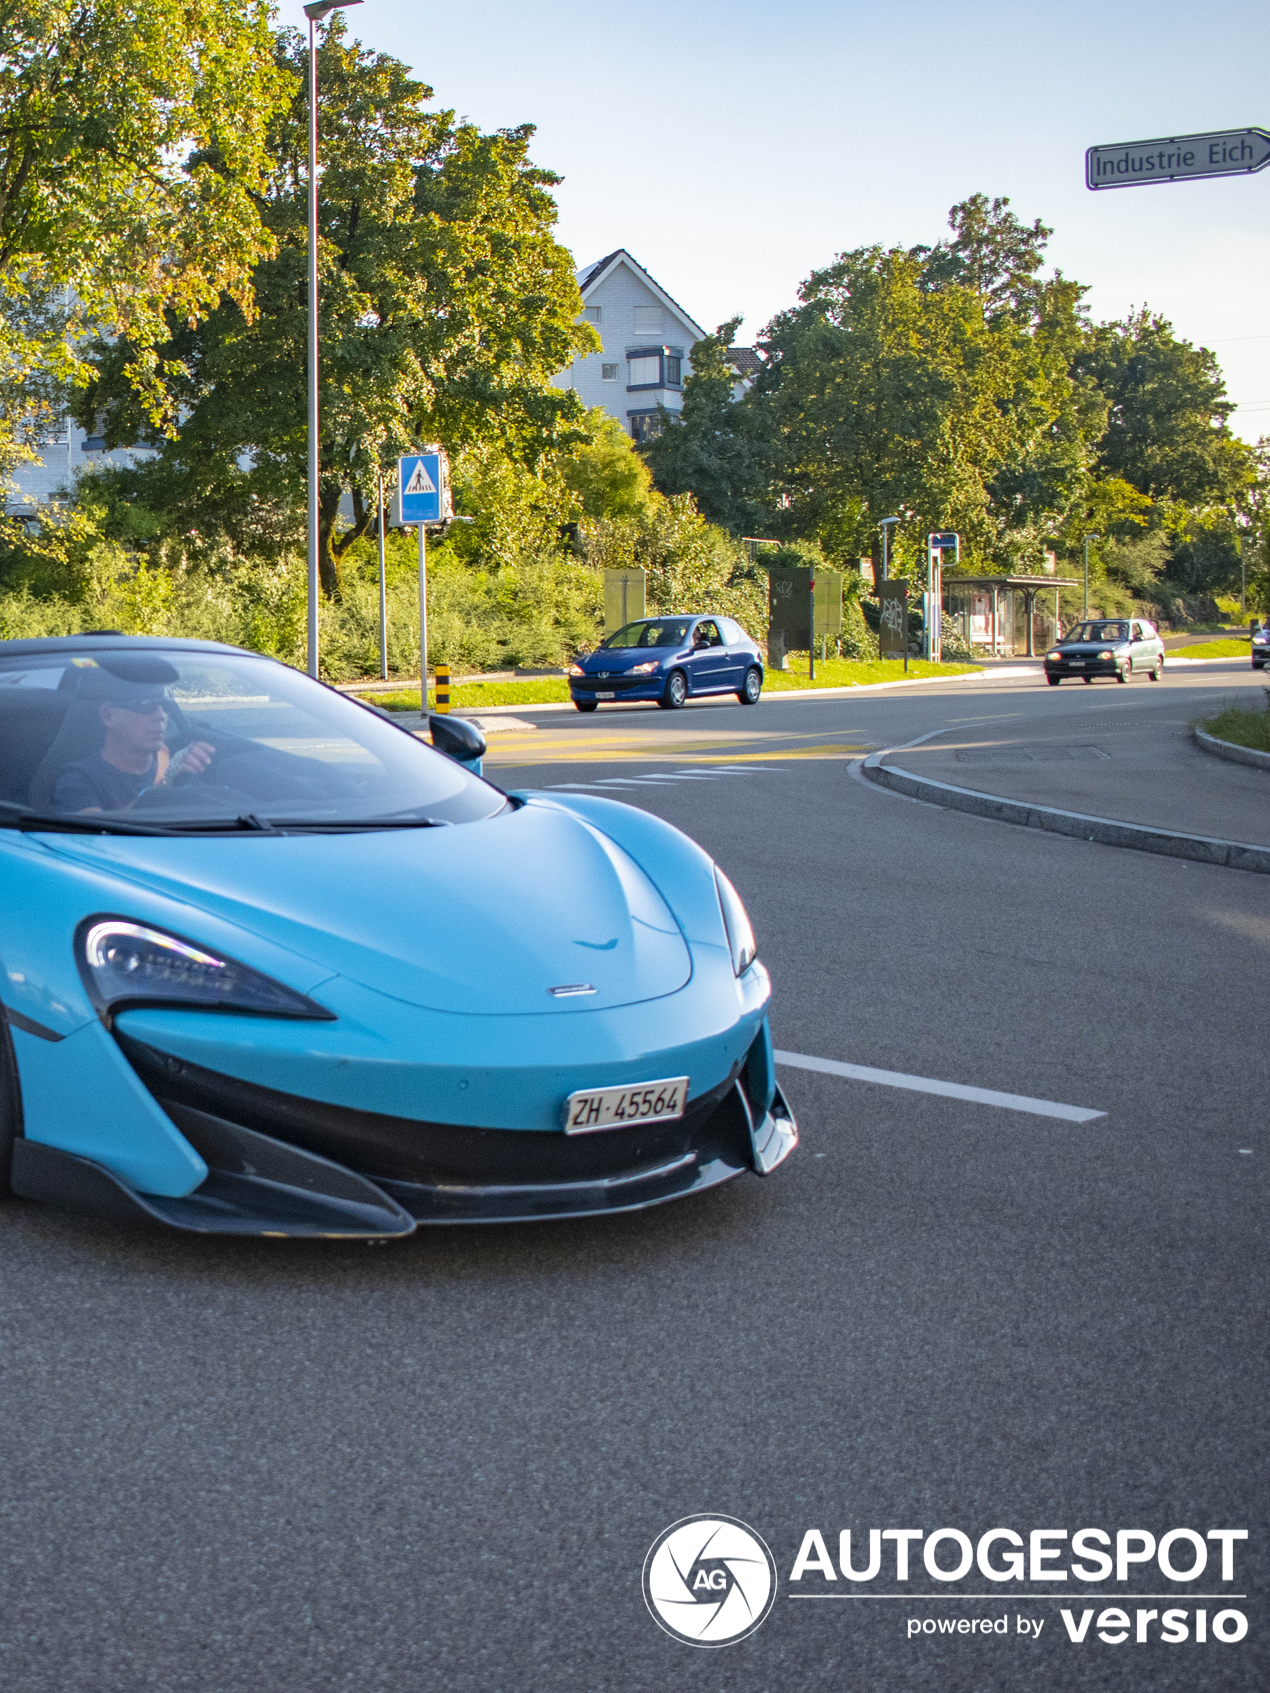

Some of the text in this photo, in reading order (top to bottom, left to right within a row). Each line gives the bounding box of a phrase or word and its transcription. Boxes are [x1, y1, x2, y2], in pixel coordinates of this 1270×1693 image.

[1096, 139, 1253, 176] Industrie Eich
[572, 1087, 679, 1126] ZH 45564
